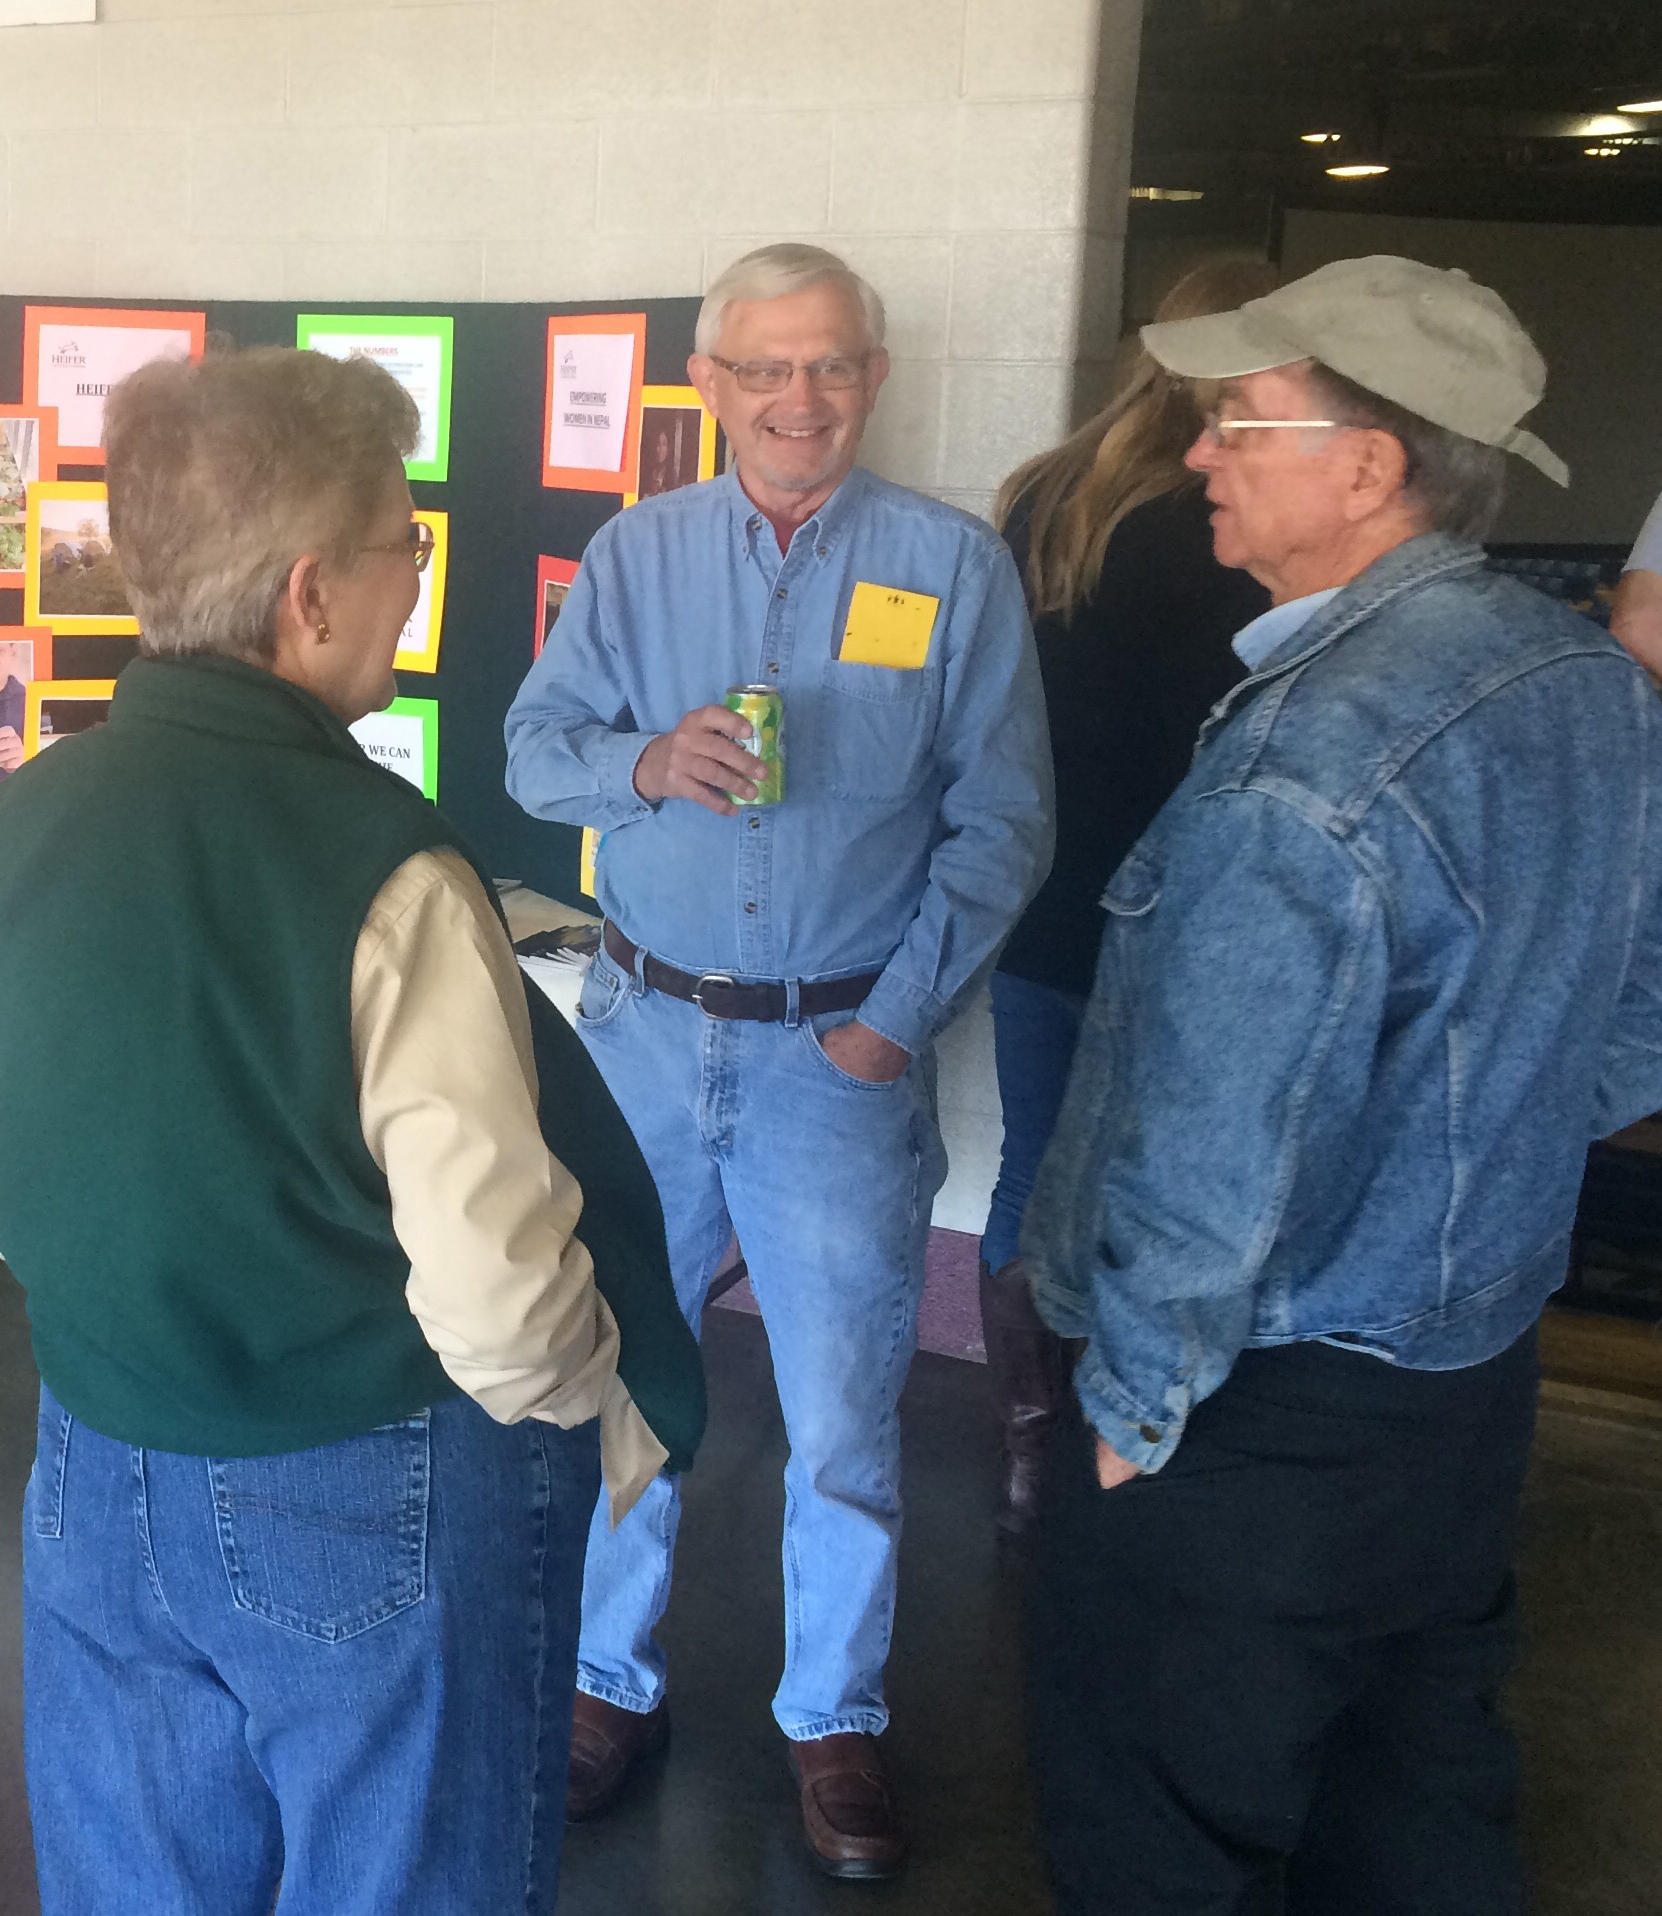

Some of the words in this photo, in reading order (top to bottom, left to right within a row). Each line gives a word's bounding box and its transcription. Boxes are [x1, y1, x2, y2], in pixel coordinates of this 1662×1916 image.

[363, 347, 398, 356] NUMBERS
[52, 354, 86, 364] HEIFER
[564, 412, 586, 424] WOMEN
[593, 414, 610, 427] NEPAL
[369, 744, 387, 757] WE
[389, 746, 411, 759] CAN
